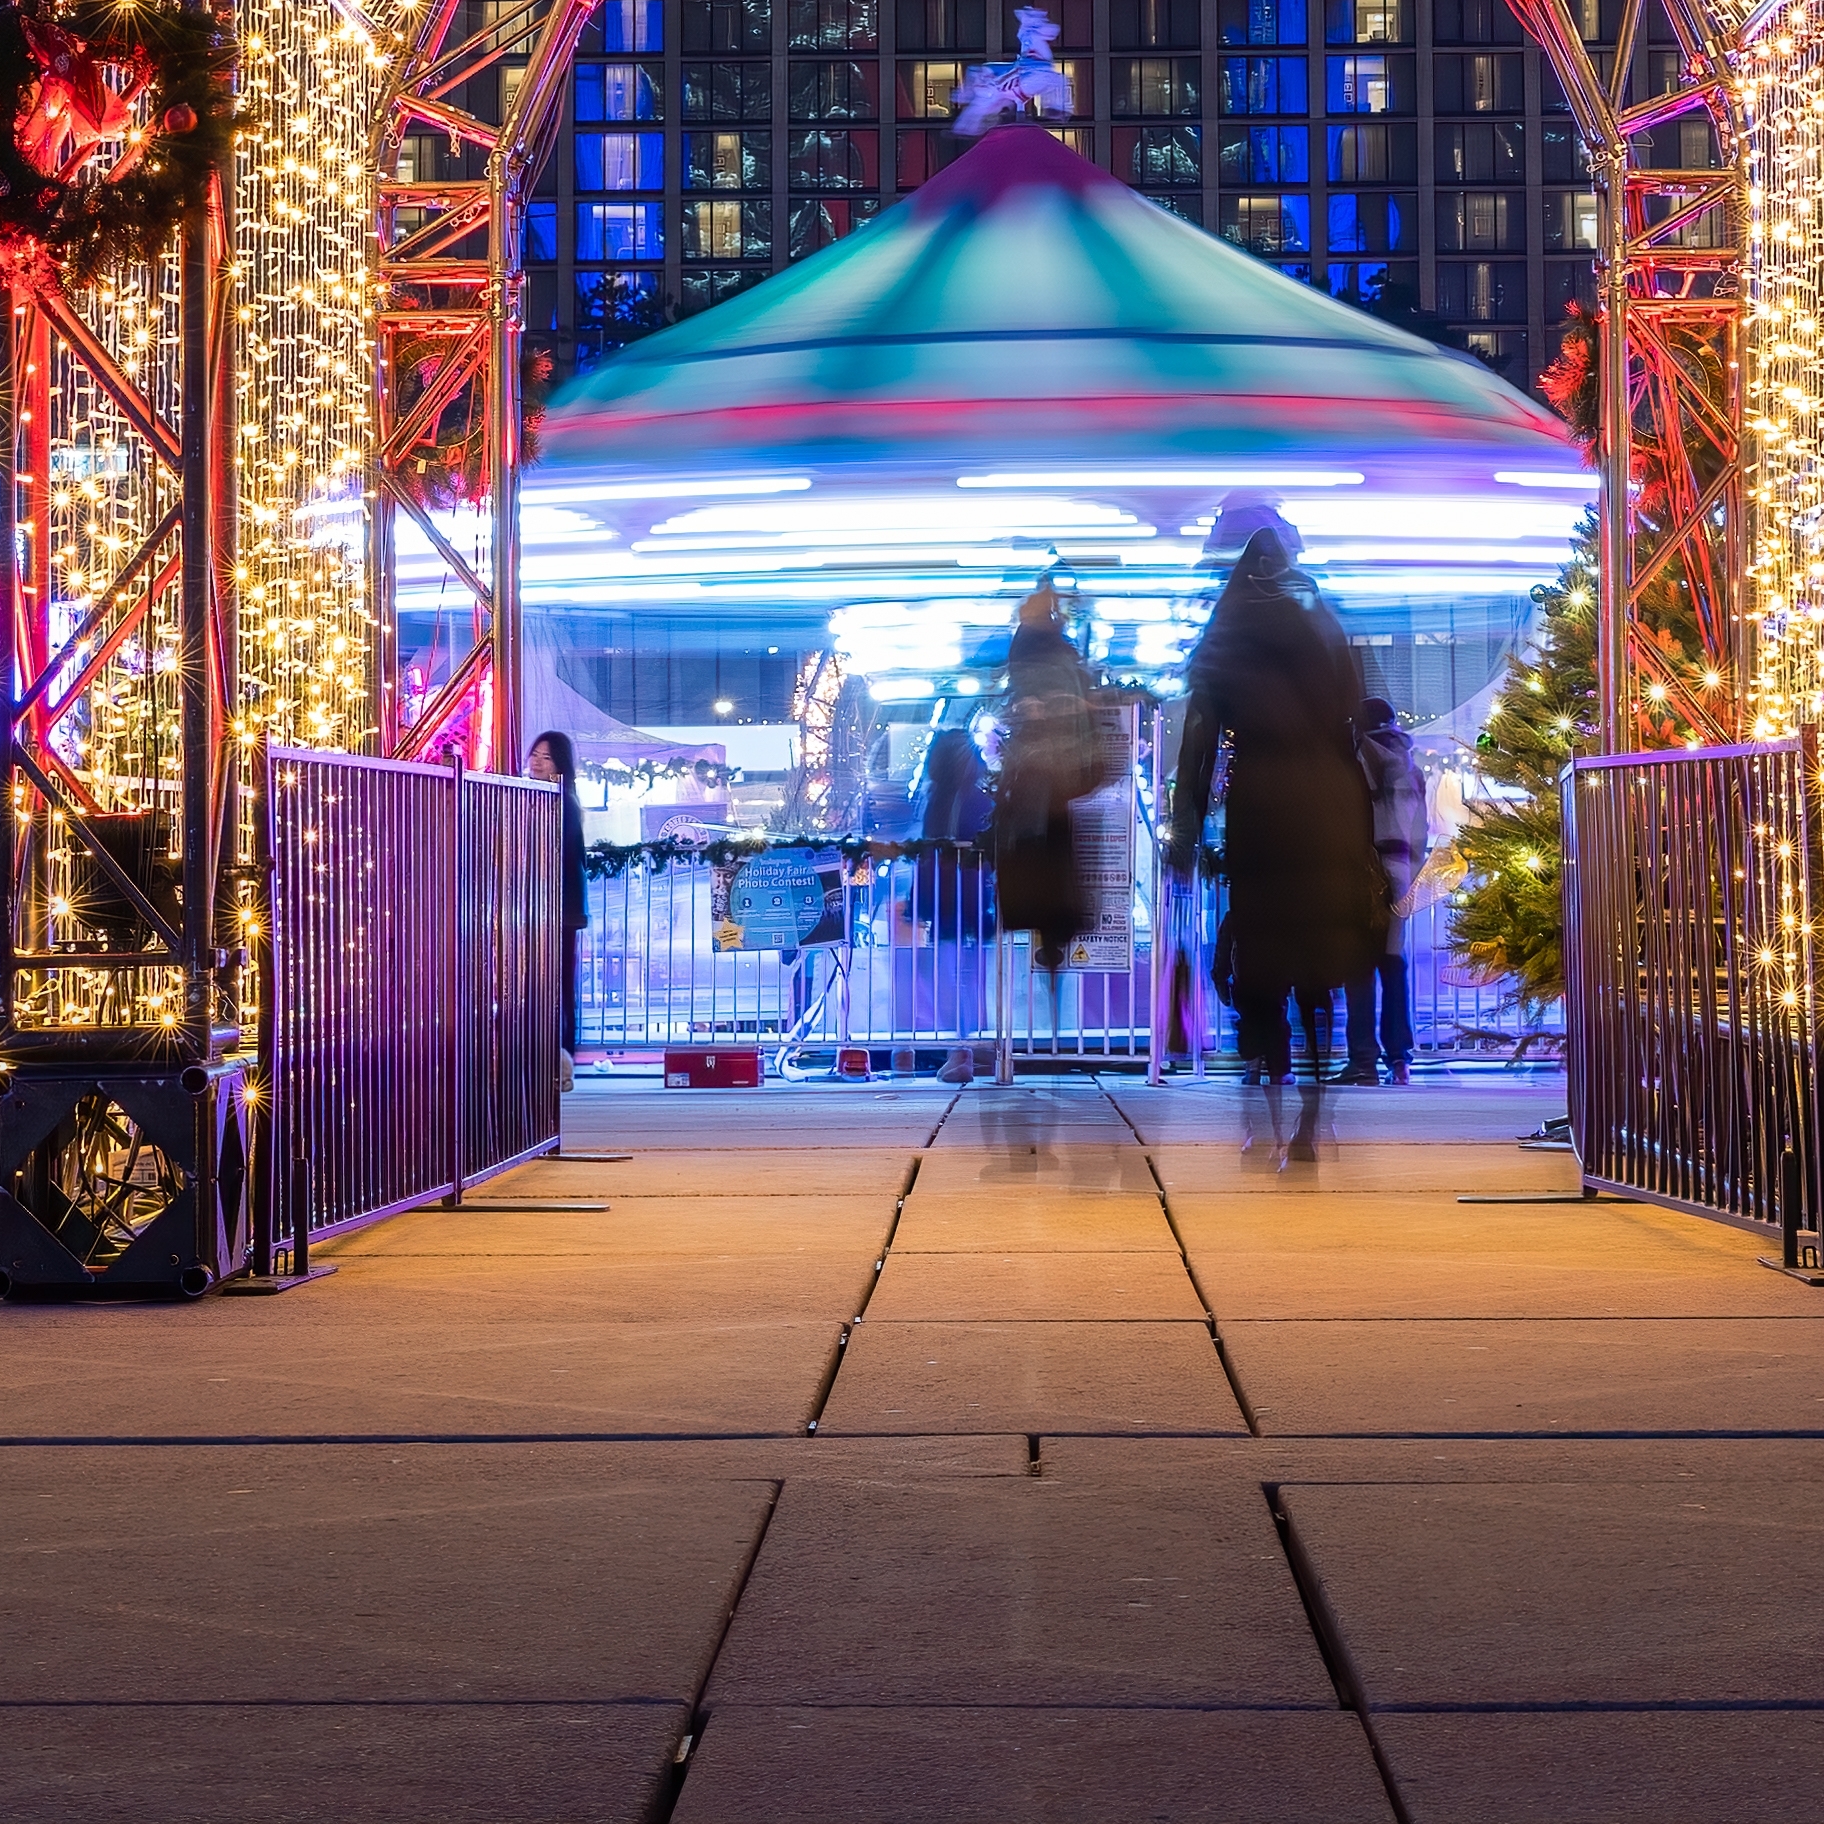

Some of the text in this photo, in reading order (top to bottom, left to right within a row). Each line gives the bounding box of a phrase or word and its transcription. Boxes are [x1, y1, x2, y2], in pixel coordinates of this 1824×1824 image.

[745, 865, 807, 878] Holiday Fair
[738, 876, 815, 889] Photo Contest!
[1101, 914, 1113, 925] NO
[1079, 935, 1128, 943] SAFETY NOTICE
